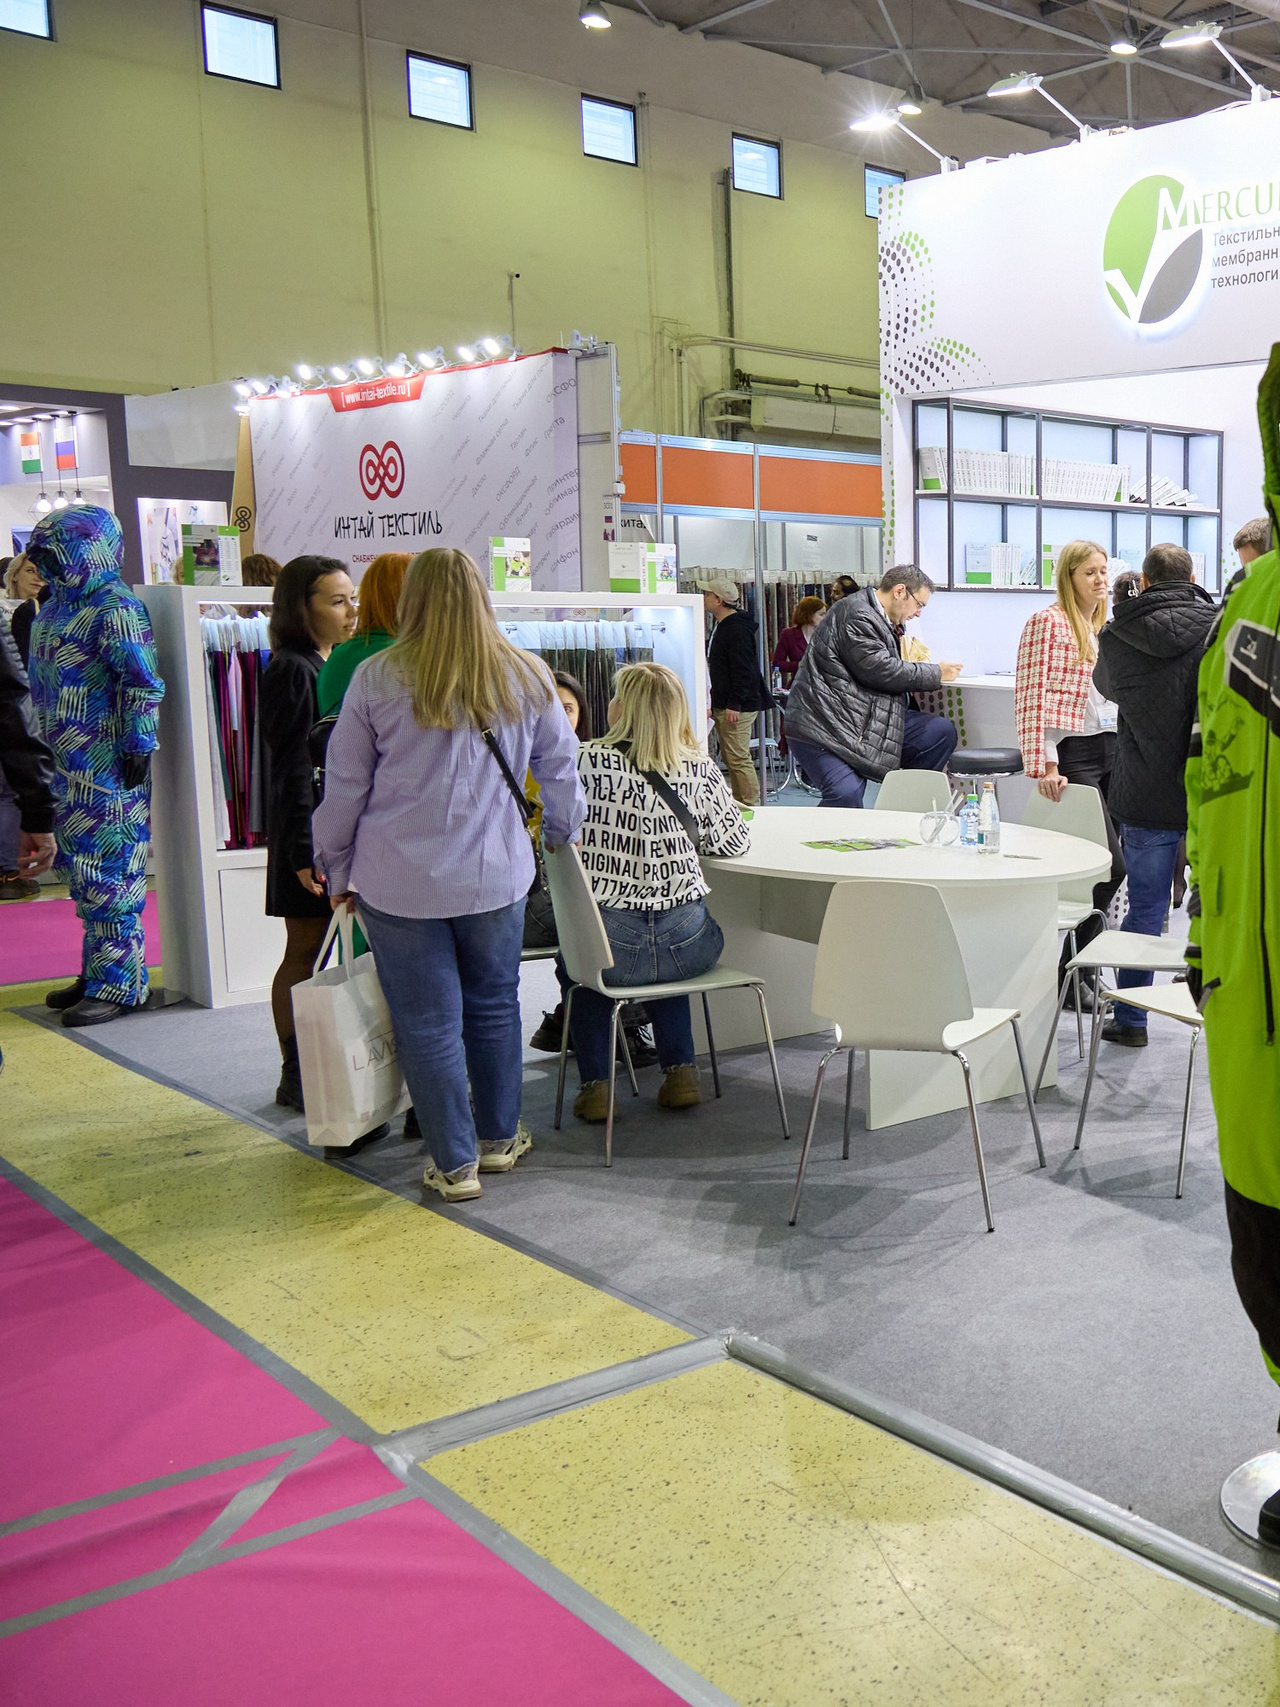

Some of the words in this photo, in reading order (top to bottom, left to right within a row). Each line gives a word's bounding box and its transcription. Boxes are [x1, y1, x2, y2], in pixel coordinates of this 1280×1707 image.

[335, 511, 376, 539] ИНТАЙ
[377, 510, 443, 538] ТЕКСТИЛЬ
[581, 850, 640, 880] RIGINAL
